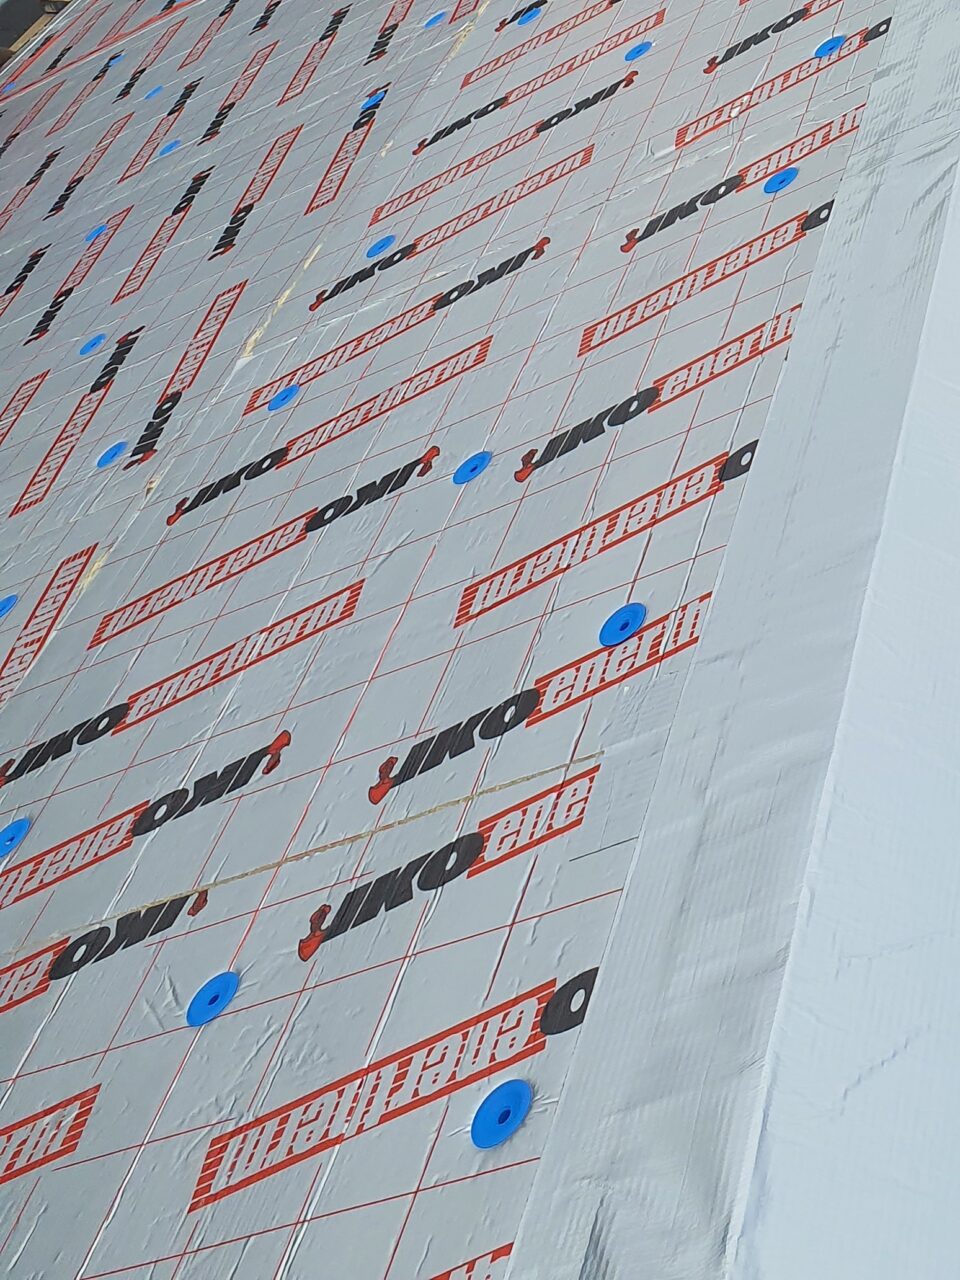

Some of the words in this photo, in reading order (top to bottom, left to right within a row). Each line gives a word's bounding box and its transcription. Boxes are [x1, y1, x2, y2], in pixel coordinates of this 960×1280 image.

[365, 22, 398, 60] IKO
[714, 6, 808, 66] IKO
[352, 87, 389, 131] KO
[171, 171, 212, 216] IKO
[210, 202, 254, 253] IKO
[232, 126, 301, 214] enertherm
[307, 119, 374, 212] enertherm
[633, 174, 742, 244] IKO
[741, 106, 863, 189] enerth
[113, 204, 191, 300] enertherm
[321, 242, 415, 303] IKO
[434, 244, 536, 311] IKO
[581, 215, 804, 353] enertherm
[26, 286, 74, 338] IKO
[90, 332, 142, 393] IKO
[126, 389, 183, 459] IKO
[157, 282, 245, 404] enertherm
[530, 386, 657, 469] IKO
[655, 308, 799, 407] enerth
[11, 379, 114, 514] enertherm
[176, 447, 287, 519] IKO
[280, 337, 489, 466] enertherm
[306, 454, 426, 532] IKO
[456, 458, 723, 623] enertherm
[88, 511, 313, 649] enertherm
[0, 705, 127, 789] IKO
[116, 579, 363, 732] enertherm
[384, 688, 539, 791] IKO
[535, 595, 711, 720] enerth
[130, 742, 275, 837] IKO
[0, 806, 142, 909] enert
[316, 832, 484, 945] IKO
[49, 895, 193, 981] IKO
[190, 983, 552, 1210] enertherm
